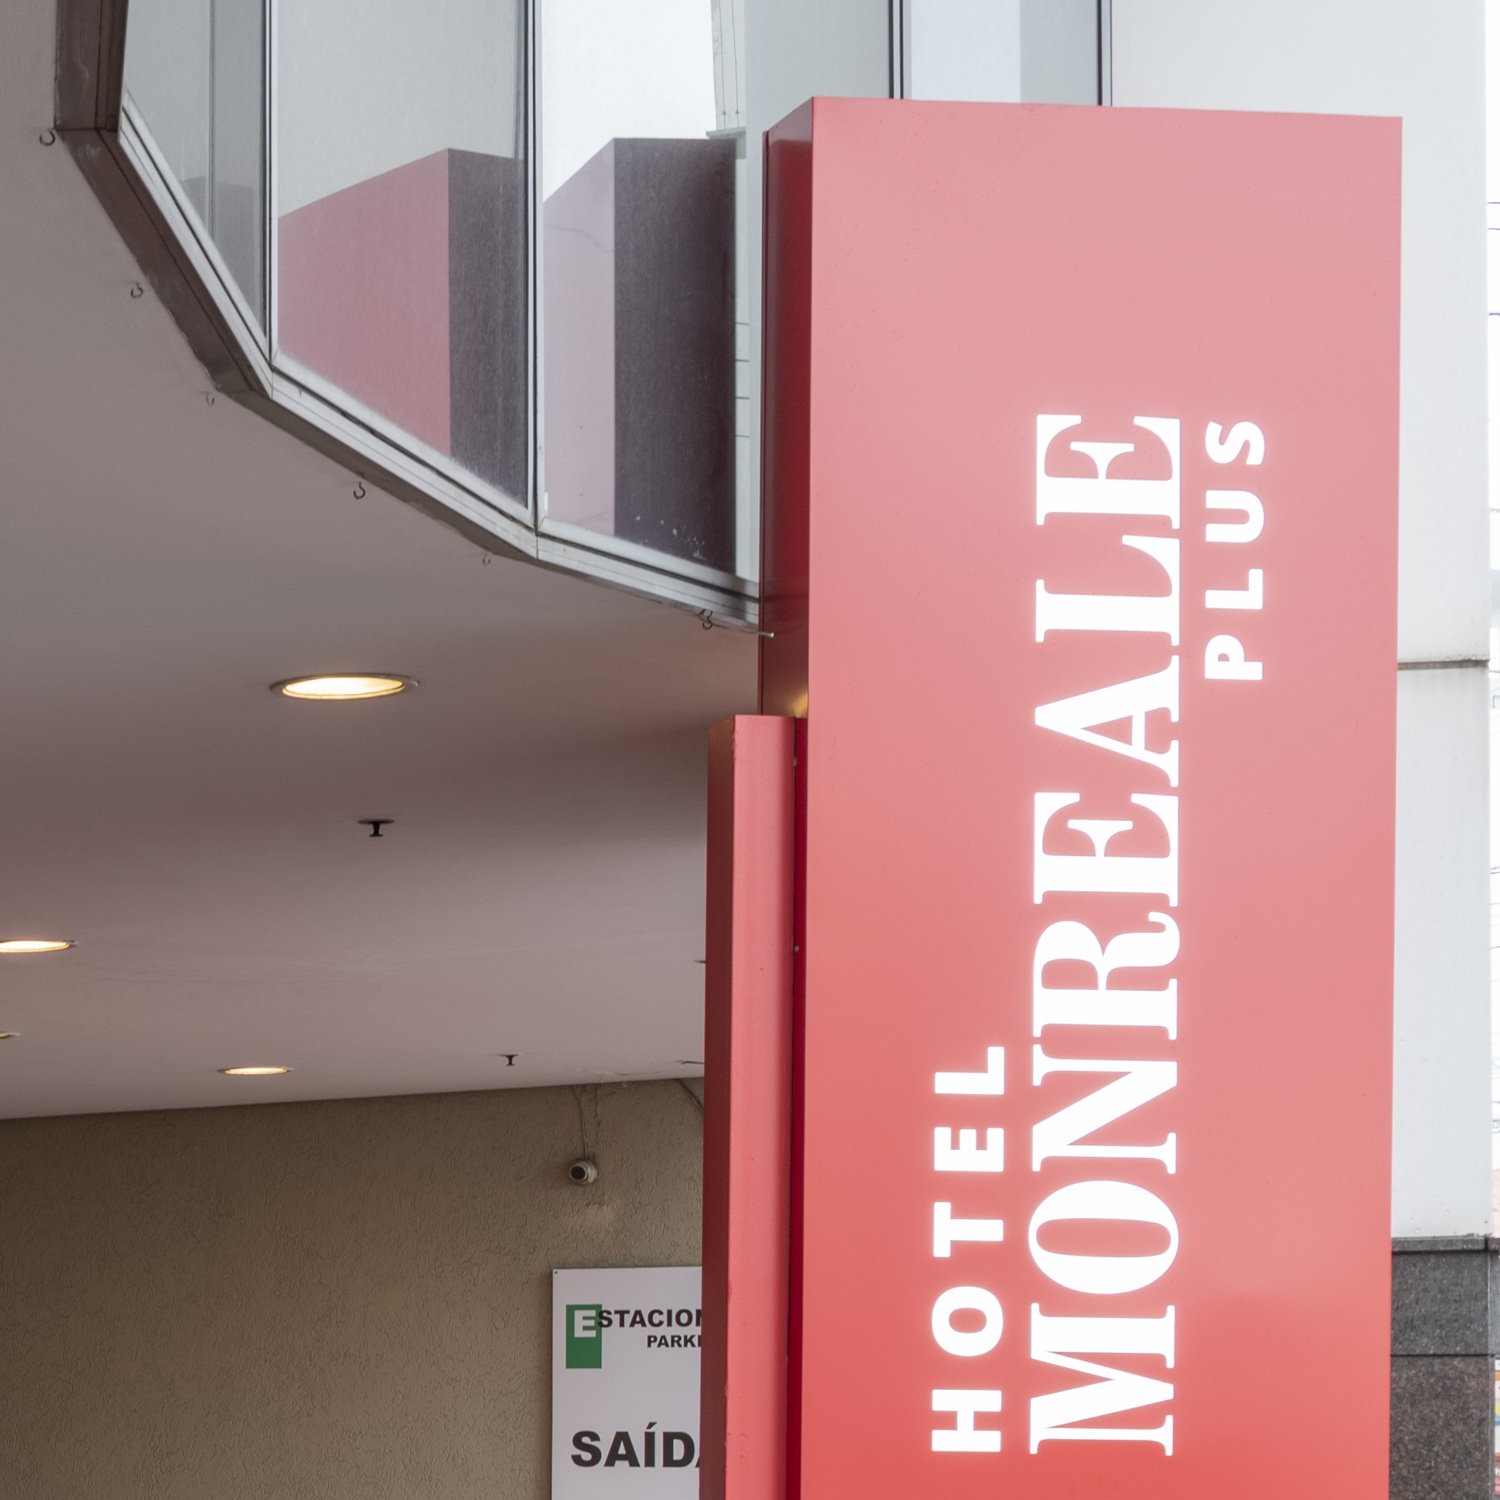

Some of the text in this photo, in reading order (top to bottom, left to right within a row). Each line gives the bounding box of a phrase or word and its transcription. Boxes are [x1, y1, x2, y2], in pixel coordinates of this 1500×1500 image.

[1203, 420, 1266, 682] PLUS
[1028, 412, 1181, 1457] MONREALE
[930, 1045, 1006, 1453] HOTEL
[571, 1422, 700, 1467] SAÍD
